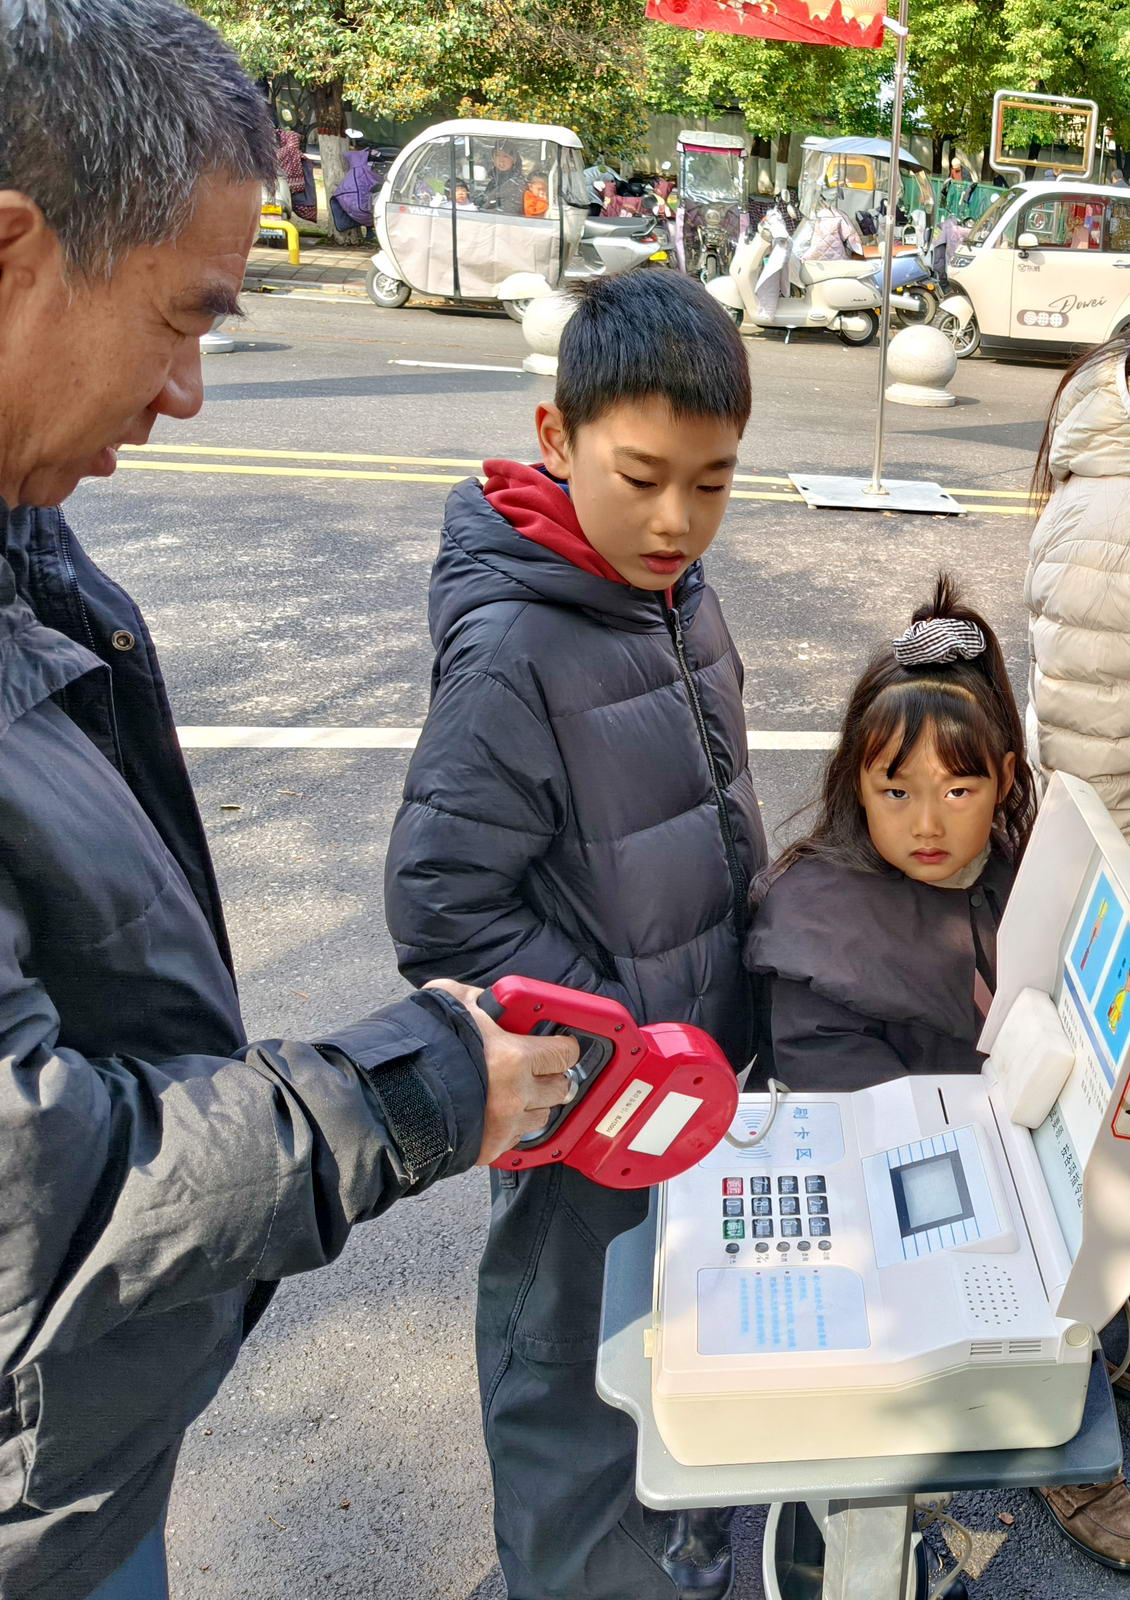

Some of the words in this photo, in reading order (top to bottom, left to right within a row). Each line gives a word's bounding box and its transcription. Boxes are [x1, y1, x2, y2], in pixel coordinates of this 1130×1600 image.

[1048, 294, 1107, 314] Dowei
[793, 1107, 812, 1161] 刷卡区
